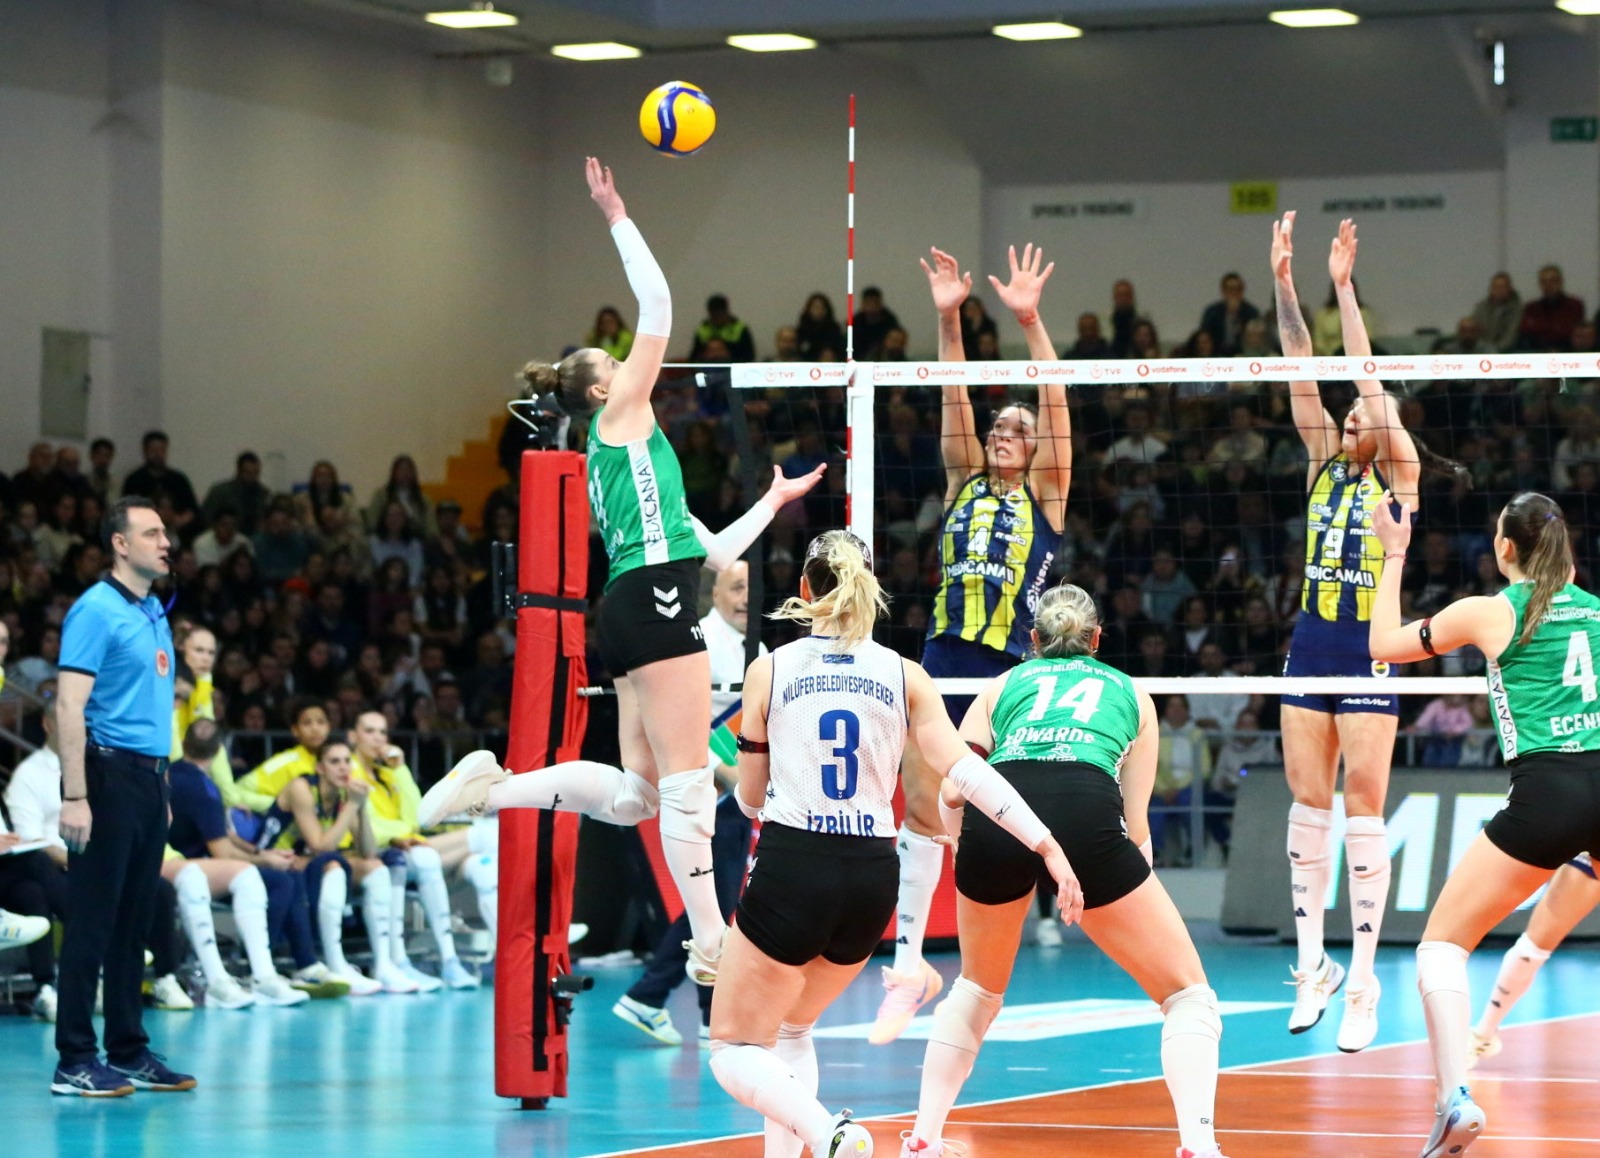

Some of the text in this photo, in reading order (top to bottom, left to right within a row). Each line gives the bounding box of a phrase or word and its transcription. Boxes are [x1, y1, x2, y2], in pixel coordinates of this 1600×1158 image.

[1040, 367, 1075, 375] vodafone
[1379, 362, 1415, 370] vodafone
[1495, 361, 1531, 369] vodafone
[967, 526, 988, 557] 4
[1325, 527, 1345, 559] 9
[1562, 631, 1598, 703] 4
[783, 676, 816, 708] NİLÜFER
[816, 671, 875, 698] BELEDİYESPOR
[1026, 675, 1104, 724] 14
[1550, 712, 1600, 737] ECEN
[819, 709, 860, 800] 3
